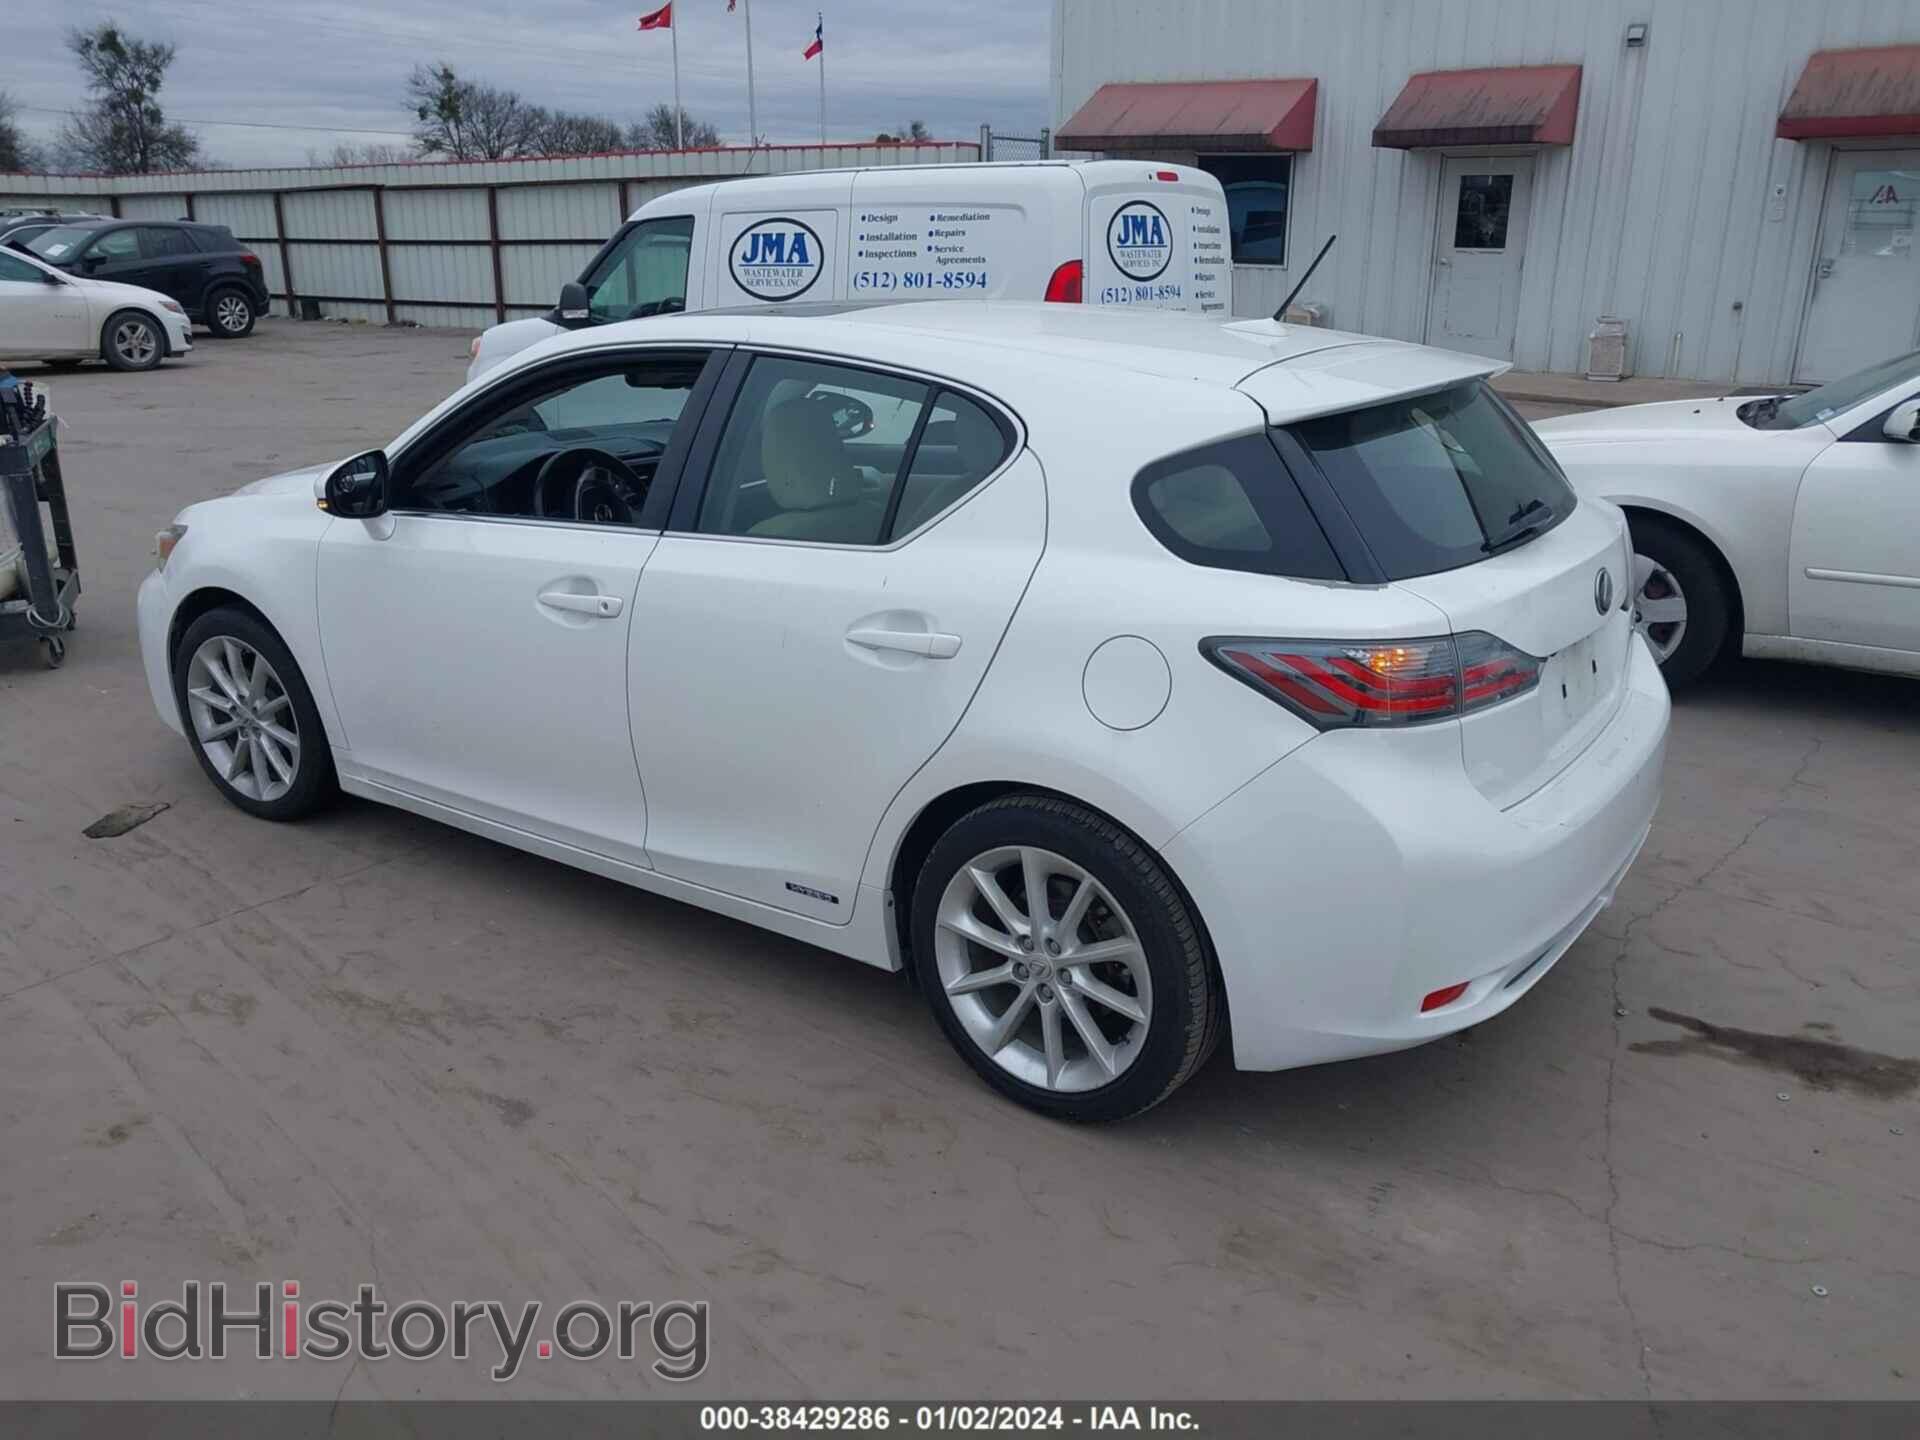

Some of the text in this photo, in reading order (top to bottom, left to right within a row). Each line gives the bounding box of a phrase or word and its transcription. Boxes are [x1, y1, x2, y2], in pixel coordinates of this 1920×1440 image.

[867, 214, 898, 224] Design
[937, 213, 990, 222] Remediation
[934, 229, 966, 239] Repairs
[1117, 214, 1165, 245] JMA
[866, 232, 918, 241] Installation
[742, 232, 809, 263] JMA
[934, 245, 964, 253] Service
[865, 249, 917, 260] Inspections
[936, 256, 987, 266] Agreements
[744, 268, 803, 278] WASTEWATER
[853, 271, 987, 292] (512) 801-8594
[1101, 285, 1181, 304] (512) 801-8594
